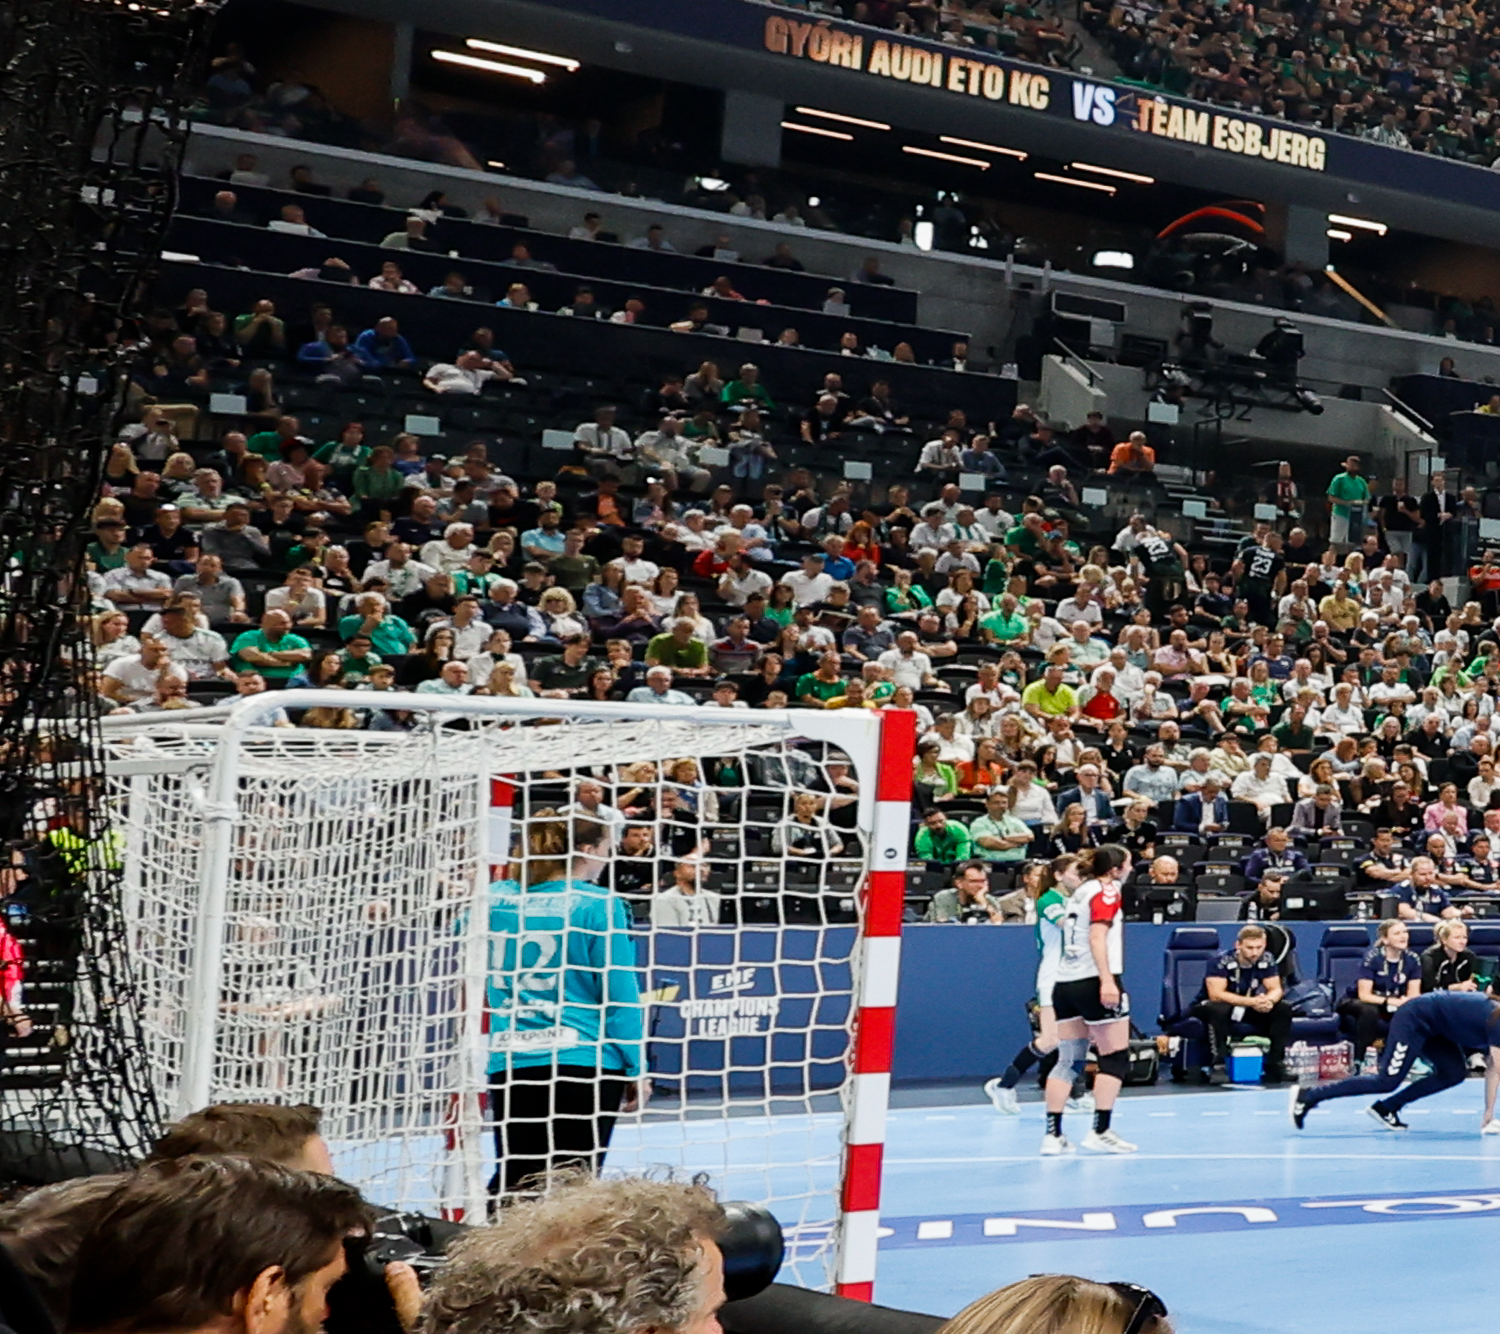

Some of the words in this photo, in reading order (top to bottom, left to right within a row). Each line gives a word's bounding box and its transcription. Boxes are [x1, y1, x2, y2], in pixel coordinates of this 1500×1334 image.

[868, 39, 942, 87] AUDI
[946, 56, 1004, 100] ETO
[1009, 71, 1049, 109] KC
[1072, 82, 1117, 126] VS
[1136, 97, 1208, 145] TEAM
[1213, 116, 1325, 171] ESBJERG
[487, 930, 556, 992] 12
[711, 968, 756, 990] EHF
[680, 997, 780, 1019] CHAMPIONS
[699, 1017, 760, 1036] LEAGUE
